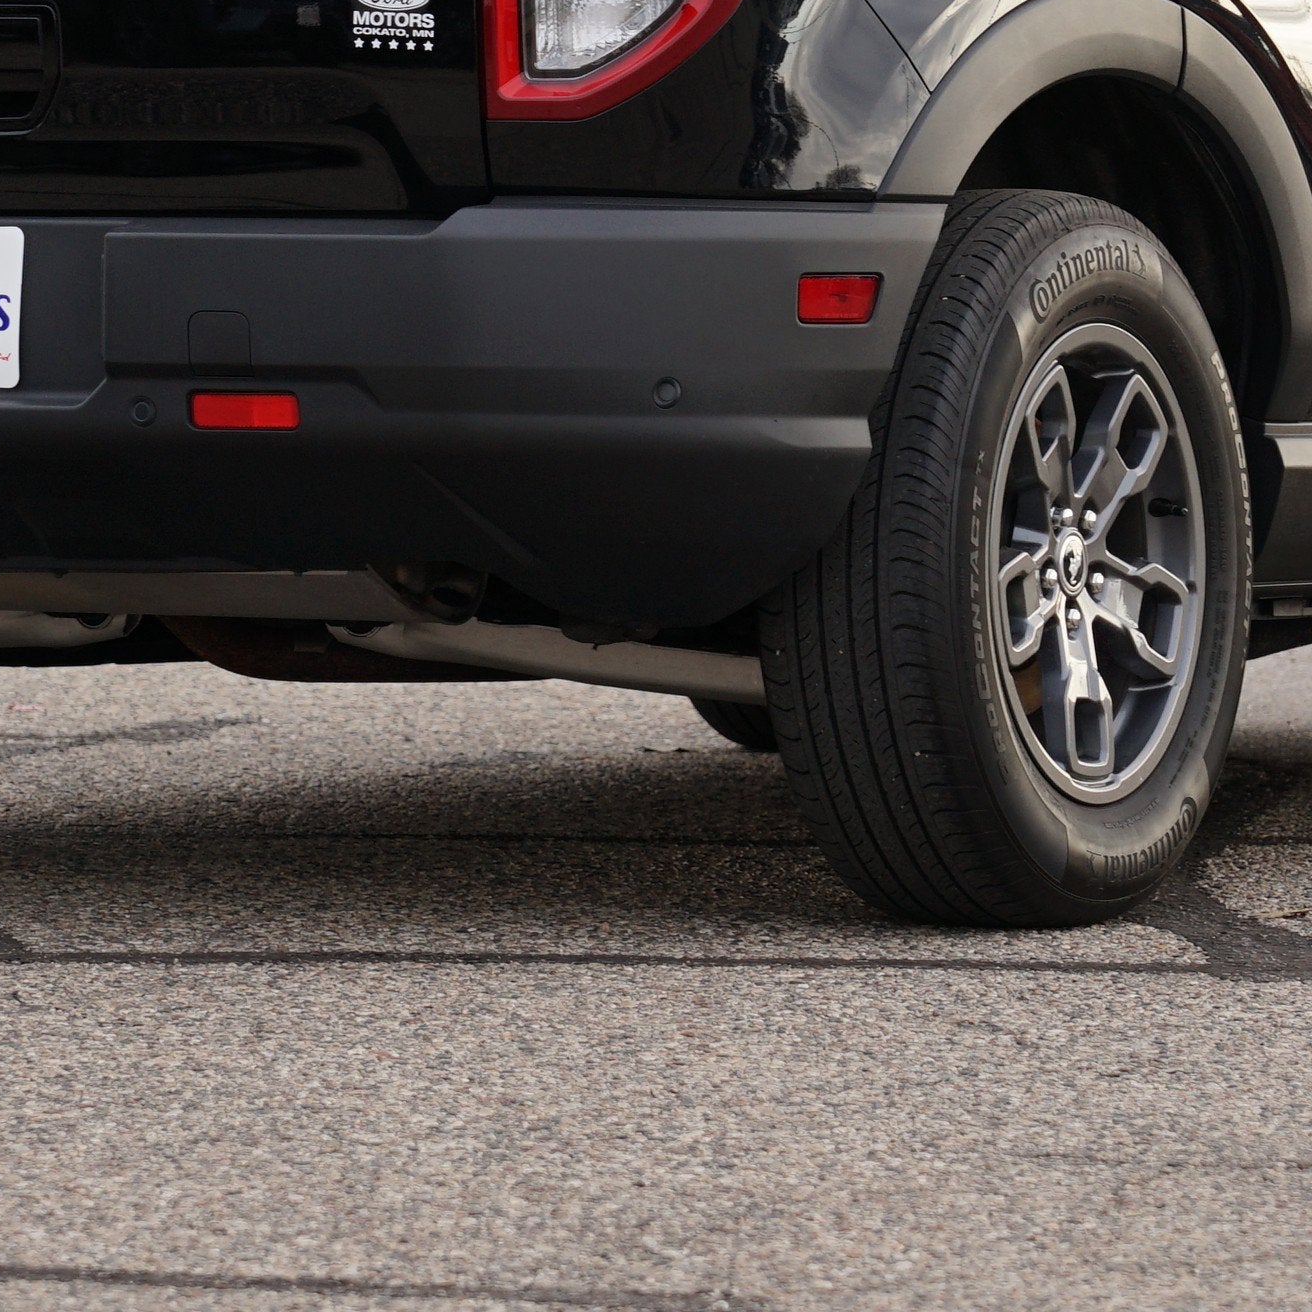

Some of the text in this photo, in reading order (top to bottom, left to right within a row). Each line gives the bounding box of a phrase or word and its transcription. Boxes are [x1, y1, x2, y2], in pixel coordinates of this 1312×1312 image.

[352, 10, 436, 29] MOTORS
[352, 27, 435, 39] COKATO, MN
[1029, 239, 1131, 324] Continental
